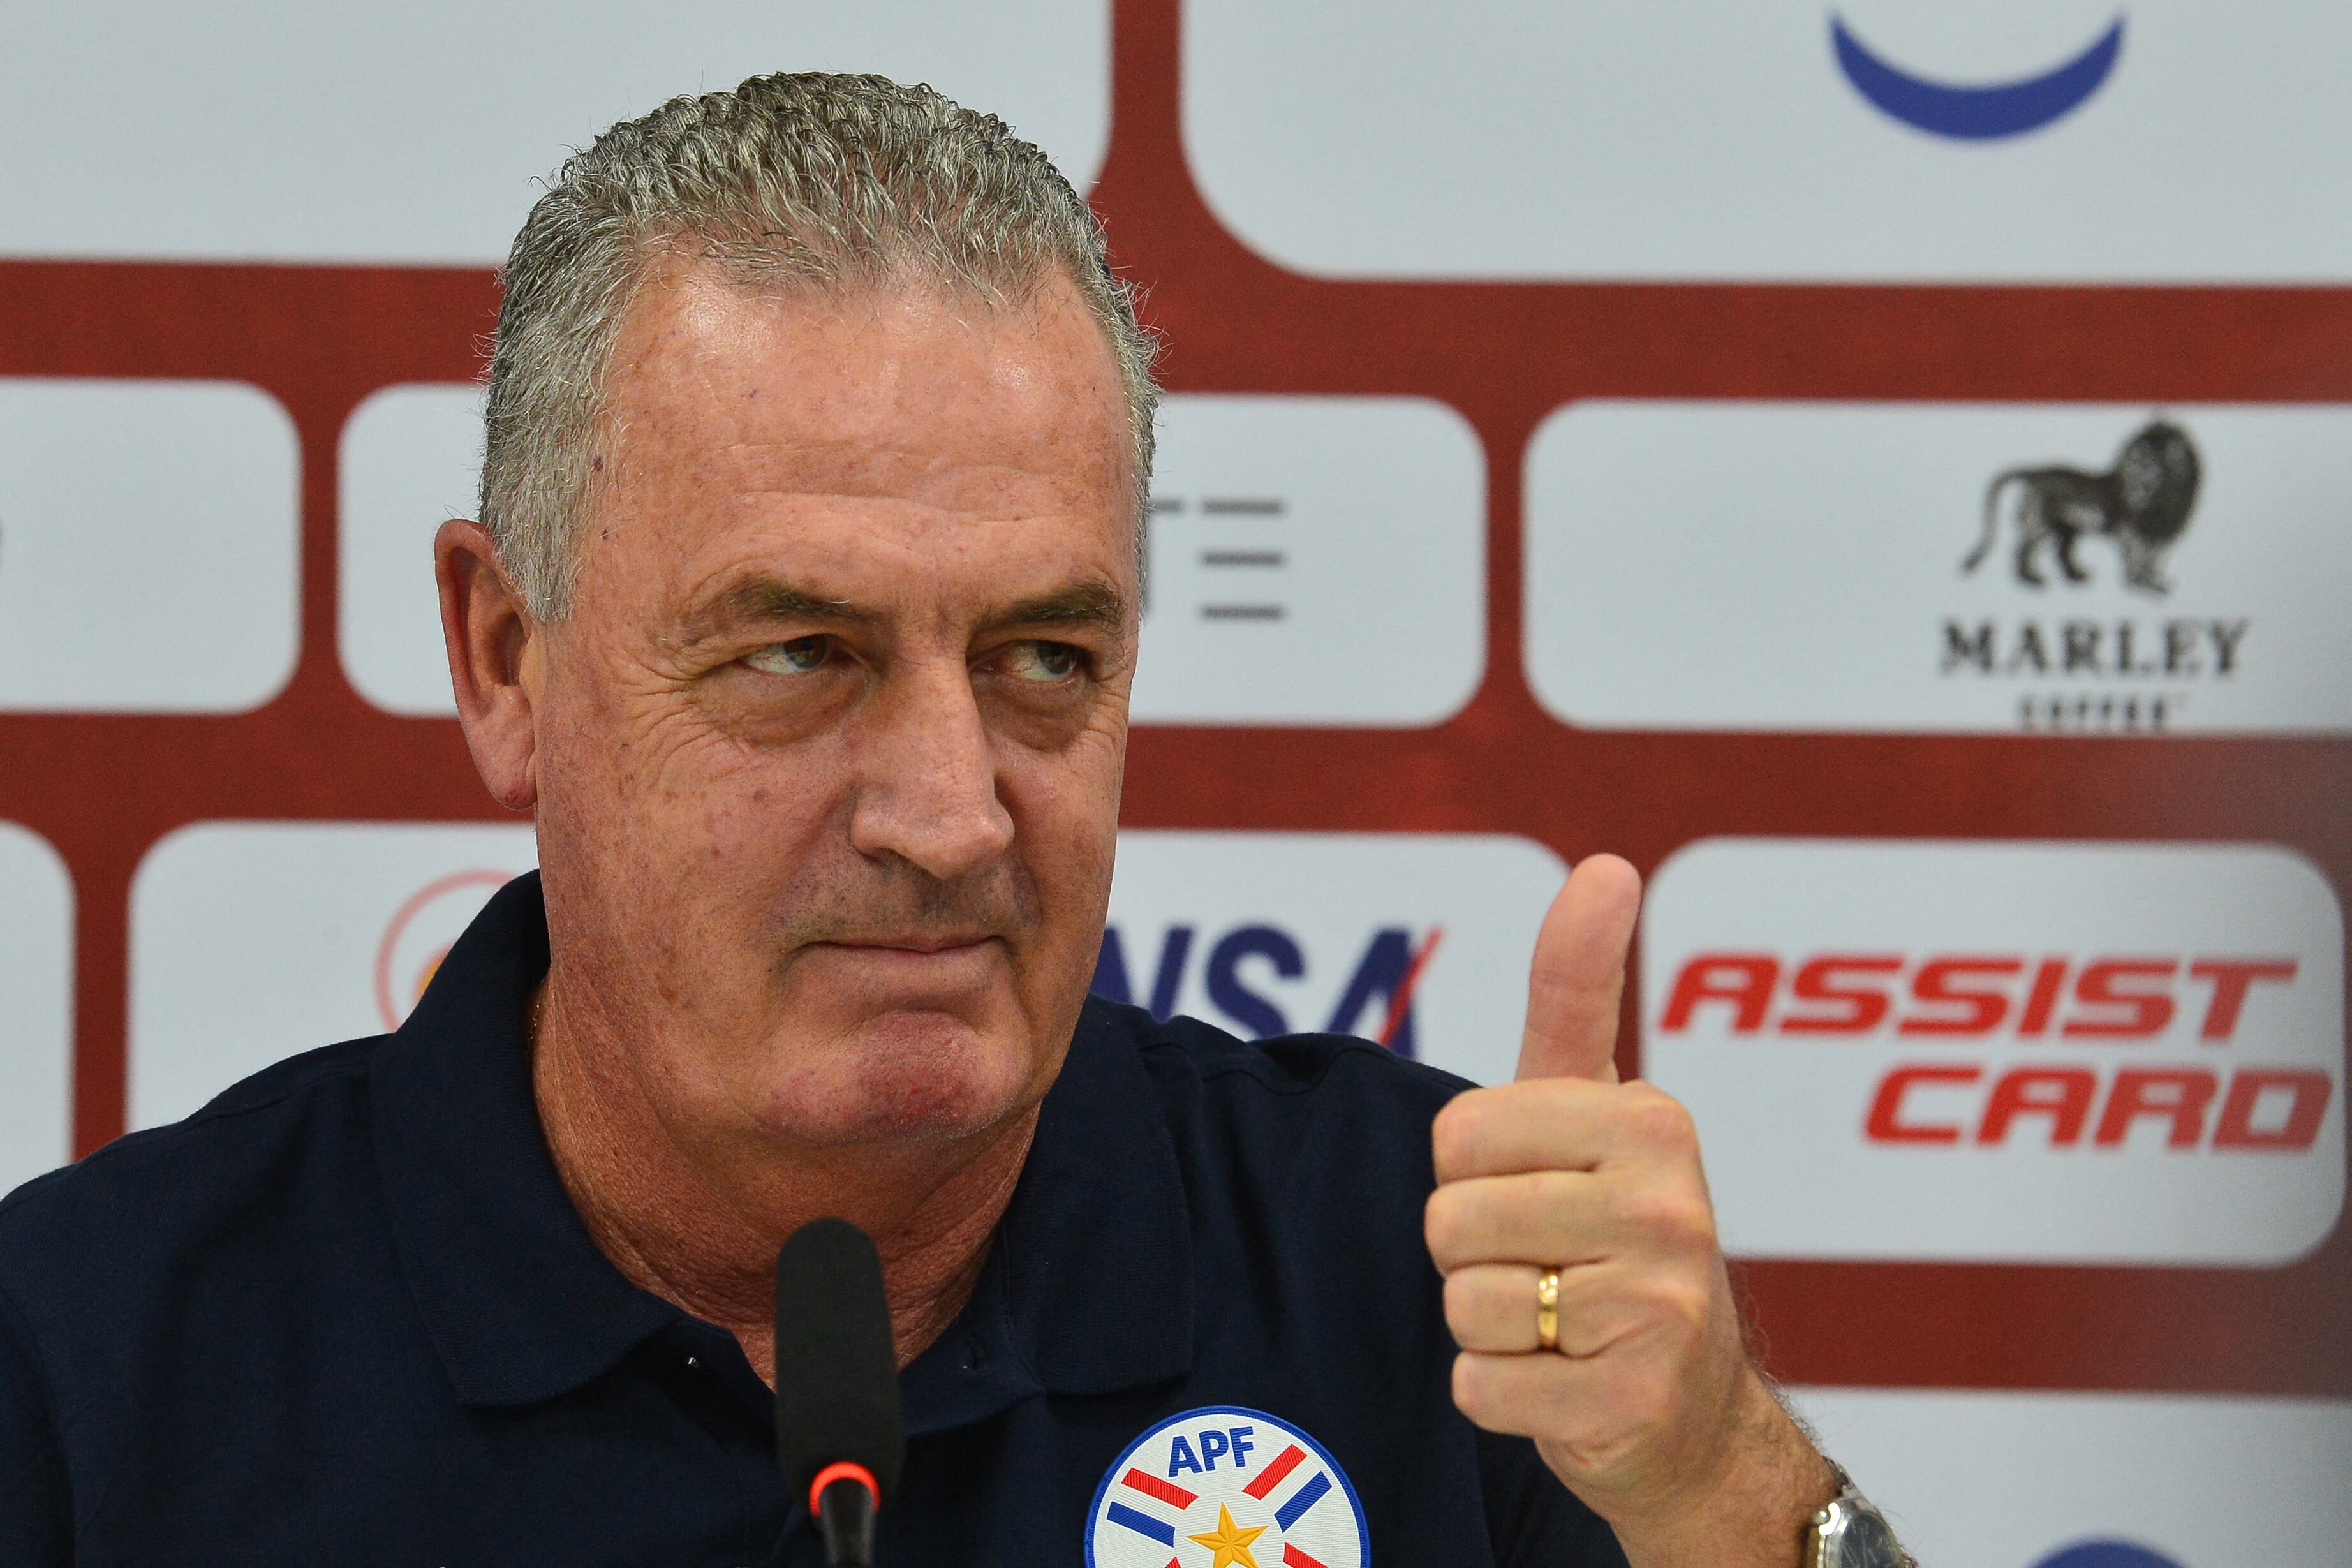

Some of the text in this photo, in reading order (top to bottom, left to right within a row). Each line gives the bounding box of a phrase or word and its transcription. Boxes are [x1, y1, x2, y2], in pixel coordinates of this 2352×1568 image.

[1941, 619, 2250, 677] MARLEY
[1660, 953, 2297, 1041] ASSIST
[1864, 1065, 2333, 1151] CARD
[1168, 1426, 1255, 1478] APF
